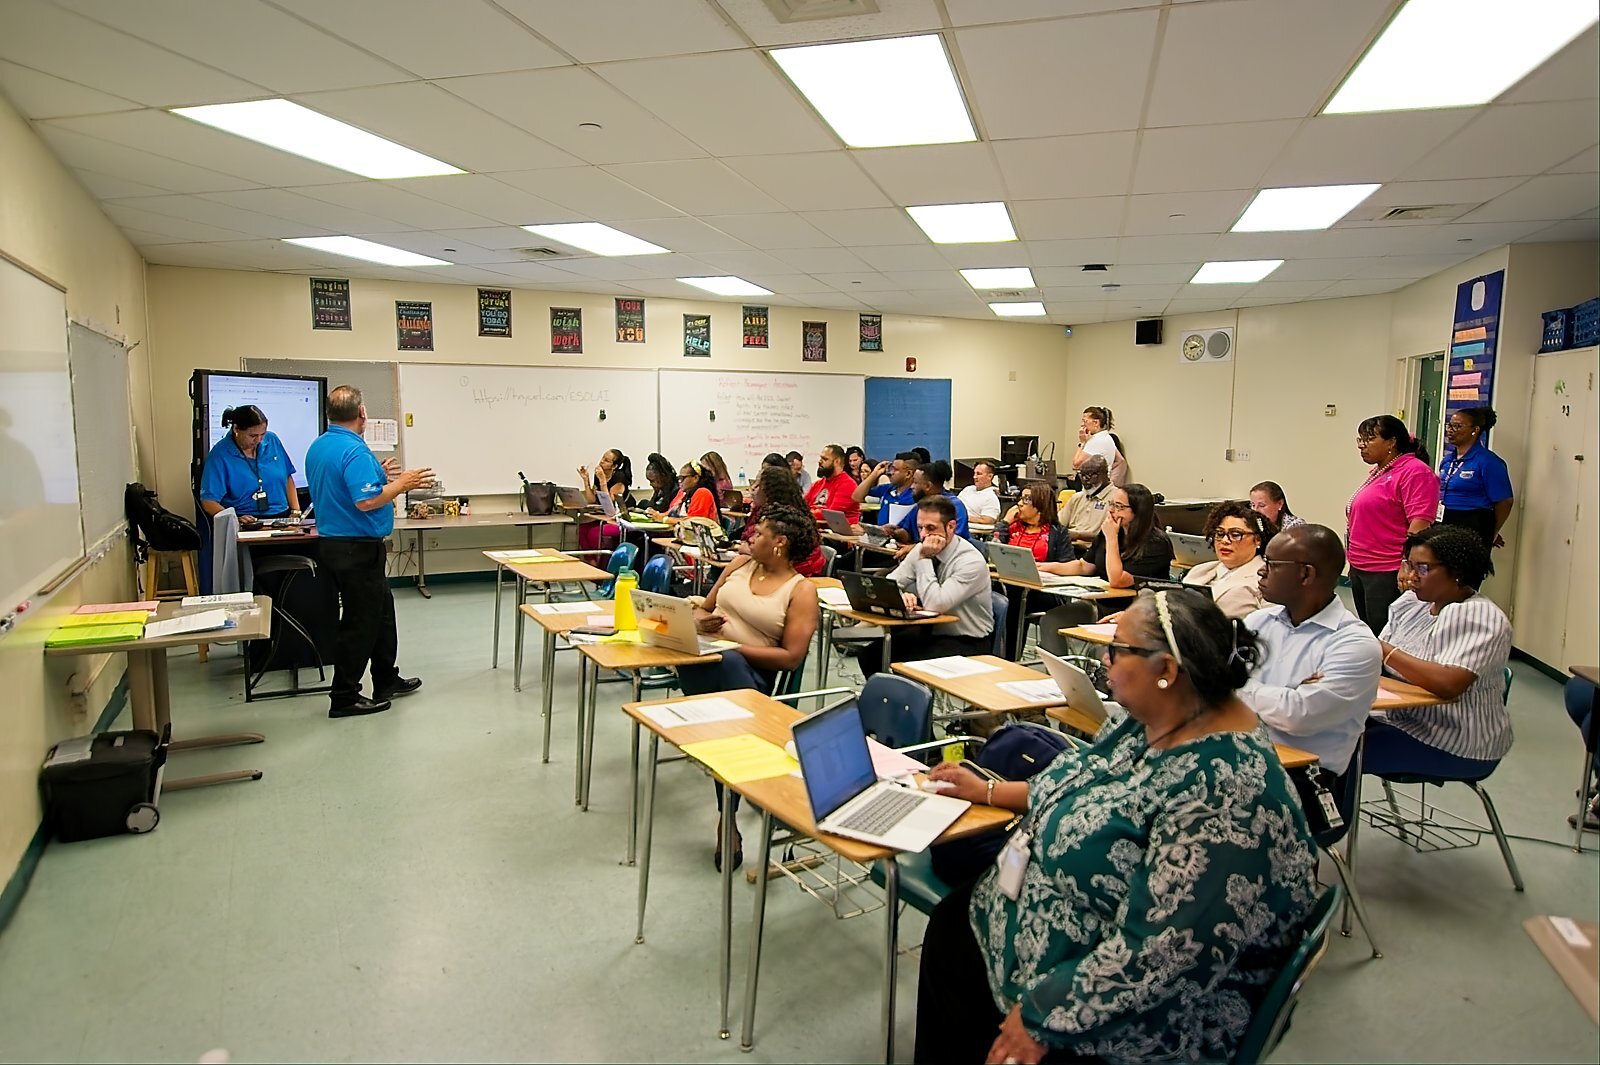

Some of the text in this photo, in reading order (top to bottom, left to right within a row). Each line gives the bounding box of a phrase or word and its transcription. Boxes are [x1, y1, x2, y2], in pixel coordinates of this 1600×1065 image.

[620, 300, 641, 311] YOUR
[481, 317, 507, 325] TODAY
[552, 317, 580, 327] wish
[744, 316, 767, 325] ARE
[552, 333, 580, 346] work
[618, 327, 643, 342] YOU
[685, 335, 710, 350] HELP
[744, 335, 767, 345] FEEL
